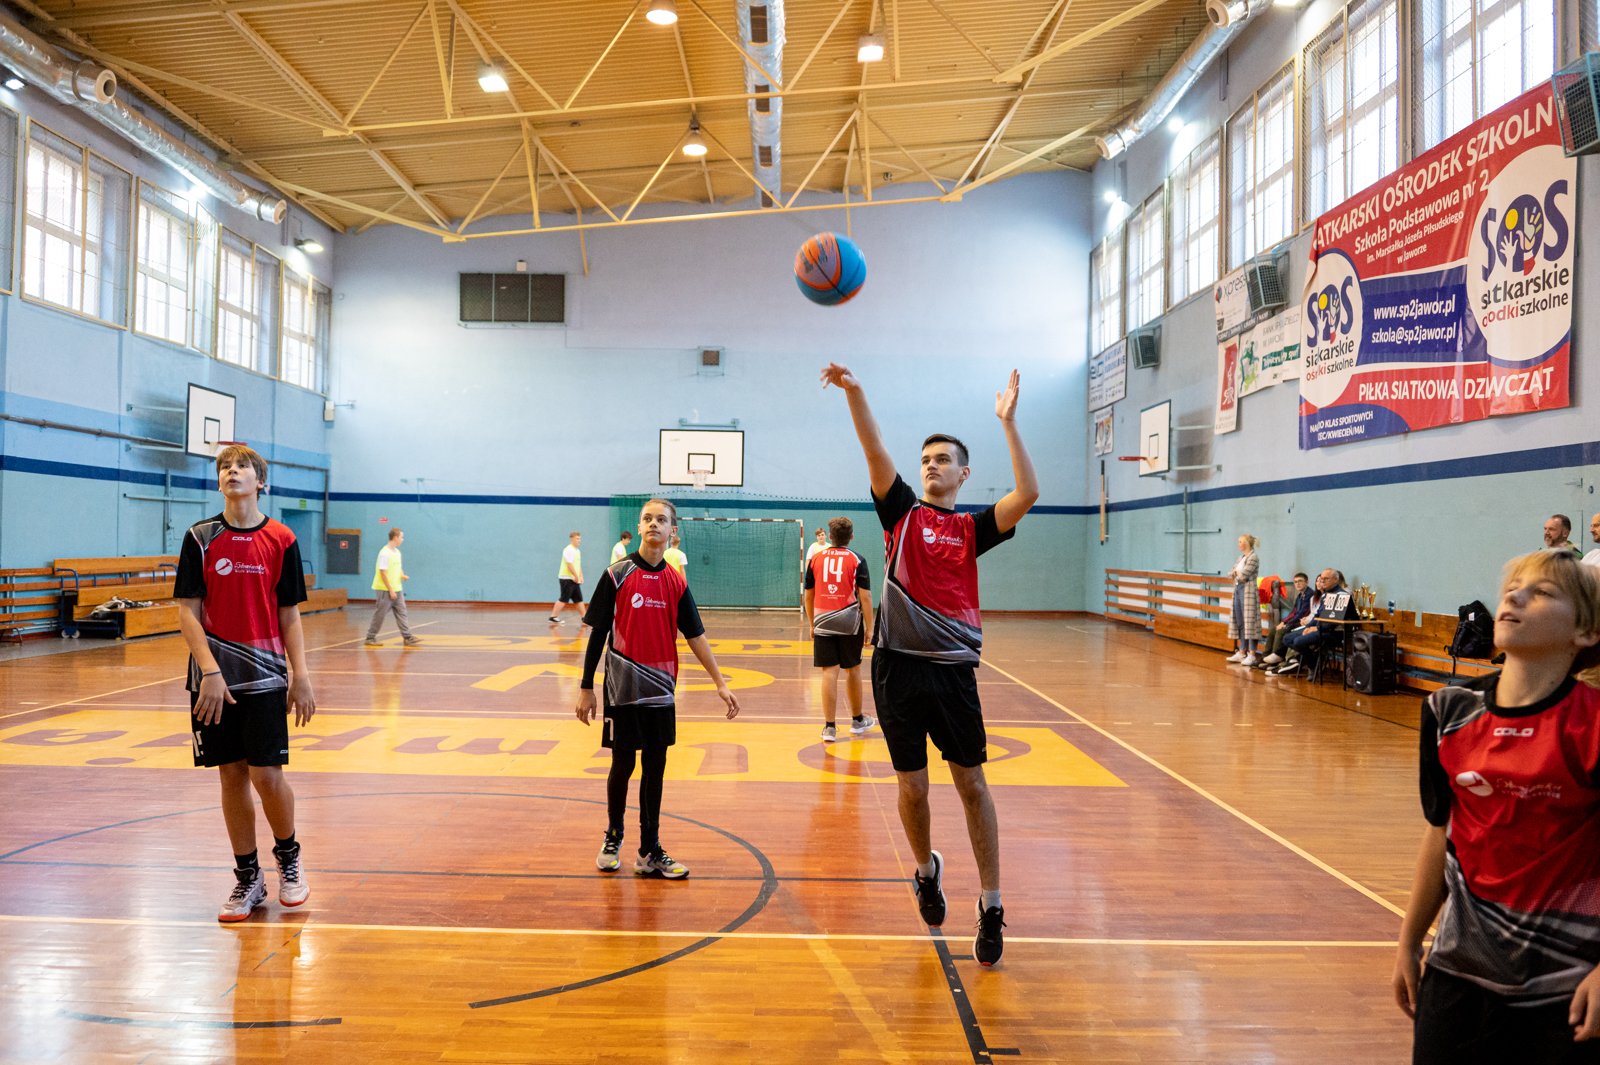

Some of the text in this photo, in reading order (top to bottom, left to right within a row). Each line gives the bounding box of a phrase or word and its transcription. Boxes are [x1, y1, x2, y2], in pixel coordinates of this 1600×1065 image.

[1313, 194, 1380, 249] ATKARSKI
[1382, 145, 1463, 213] OŚRODEK
[1354, 169, 1489, 255] Szkoła Podstawowa nr 2
[1366, 210, 1464, 265] im. Marszałka Józefa Piłsudskiego
[1397, 243, 1428, 265] w Jaworze
[1373, 294, 1456, 320] www.sp2jawor.pl
[1371, 322, 1456, 345] szkola@sp2jawor.pl
[1358, 381, 1389, 401] PIŁKA
[1390, 378, 1460, 401] SIATKOWA
[1339, 410, 1374, 426] SPORTOWYCH
[823, 556, 844, 583] 14
[1493, 727, 1535, 738] COLO
